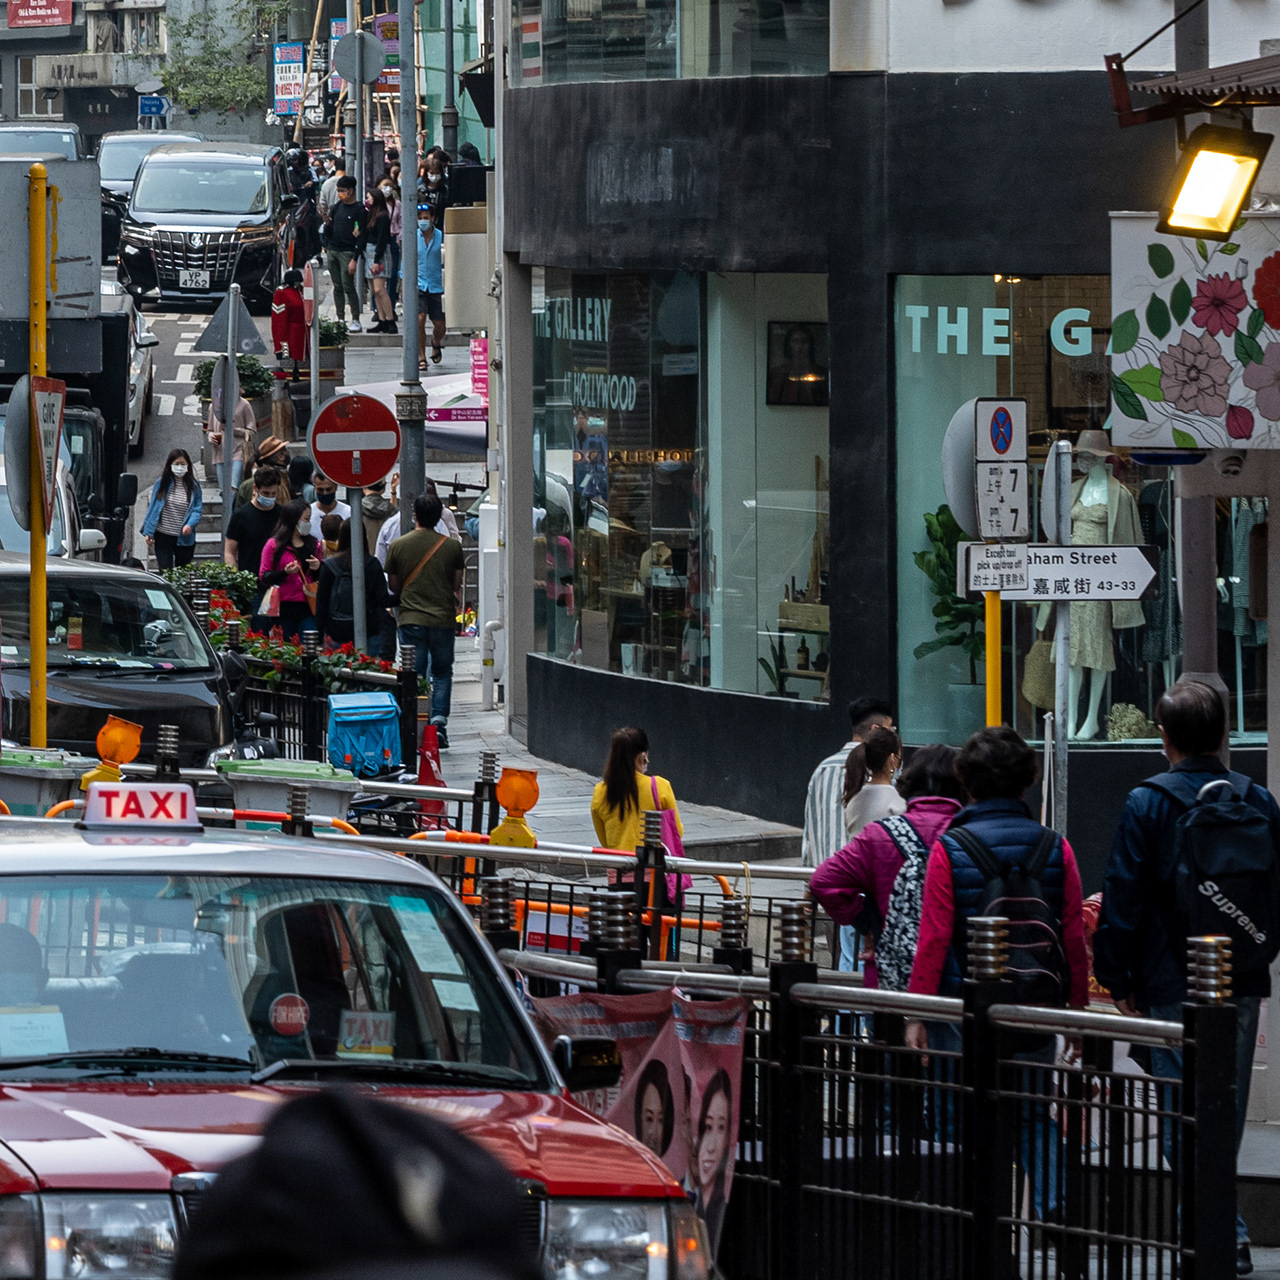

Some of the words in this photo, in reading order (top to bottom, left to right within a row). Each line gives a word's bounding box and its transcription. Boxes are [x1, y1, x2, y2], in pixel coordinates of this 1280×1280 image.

[181, 280, 208, 288] 4762
[188, 272, 201, 280] VP
[555, 297, 611, 342] GALLERY
[905, 305, 1010, 357] THE
[574, 372, 637, 411] HOLLYWOOD
[42, 402, 55, 425] GIVE
[1010, 468, 1018, 493] 7
[1010, 508, 1019, 533] 7
[977, 560, 991, 572] pick
[985, 548, 1006, 560] Except
[1006, 548, 1017, 557] taxi
[1070, 552, 1117, 565] Street
[1032, 578, 1092, 595] 嘉咸街
[1097, 580, 1136, 591] 43-33
[98, 790, 188, 819] TAXI
[1197, 880, 1267, 944] Supreme
